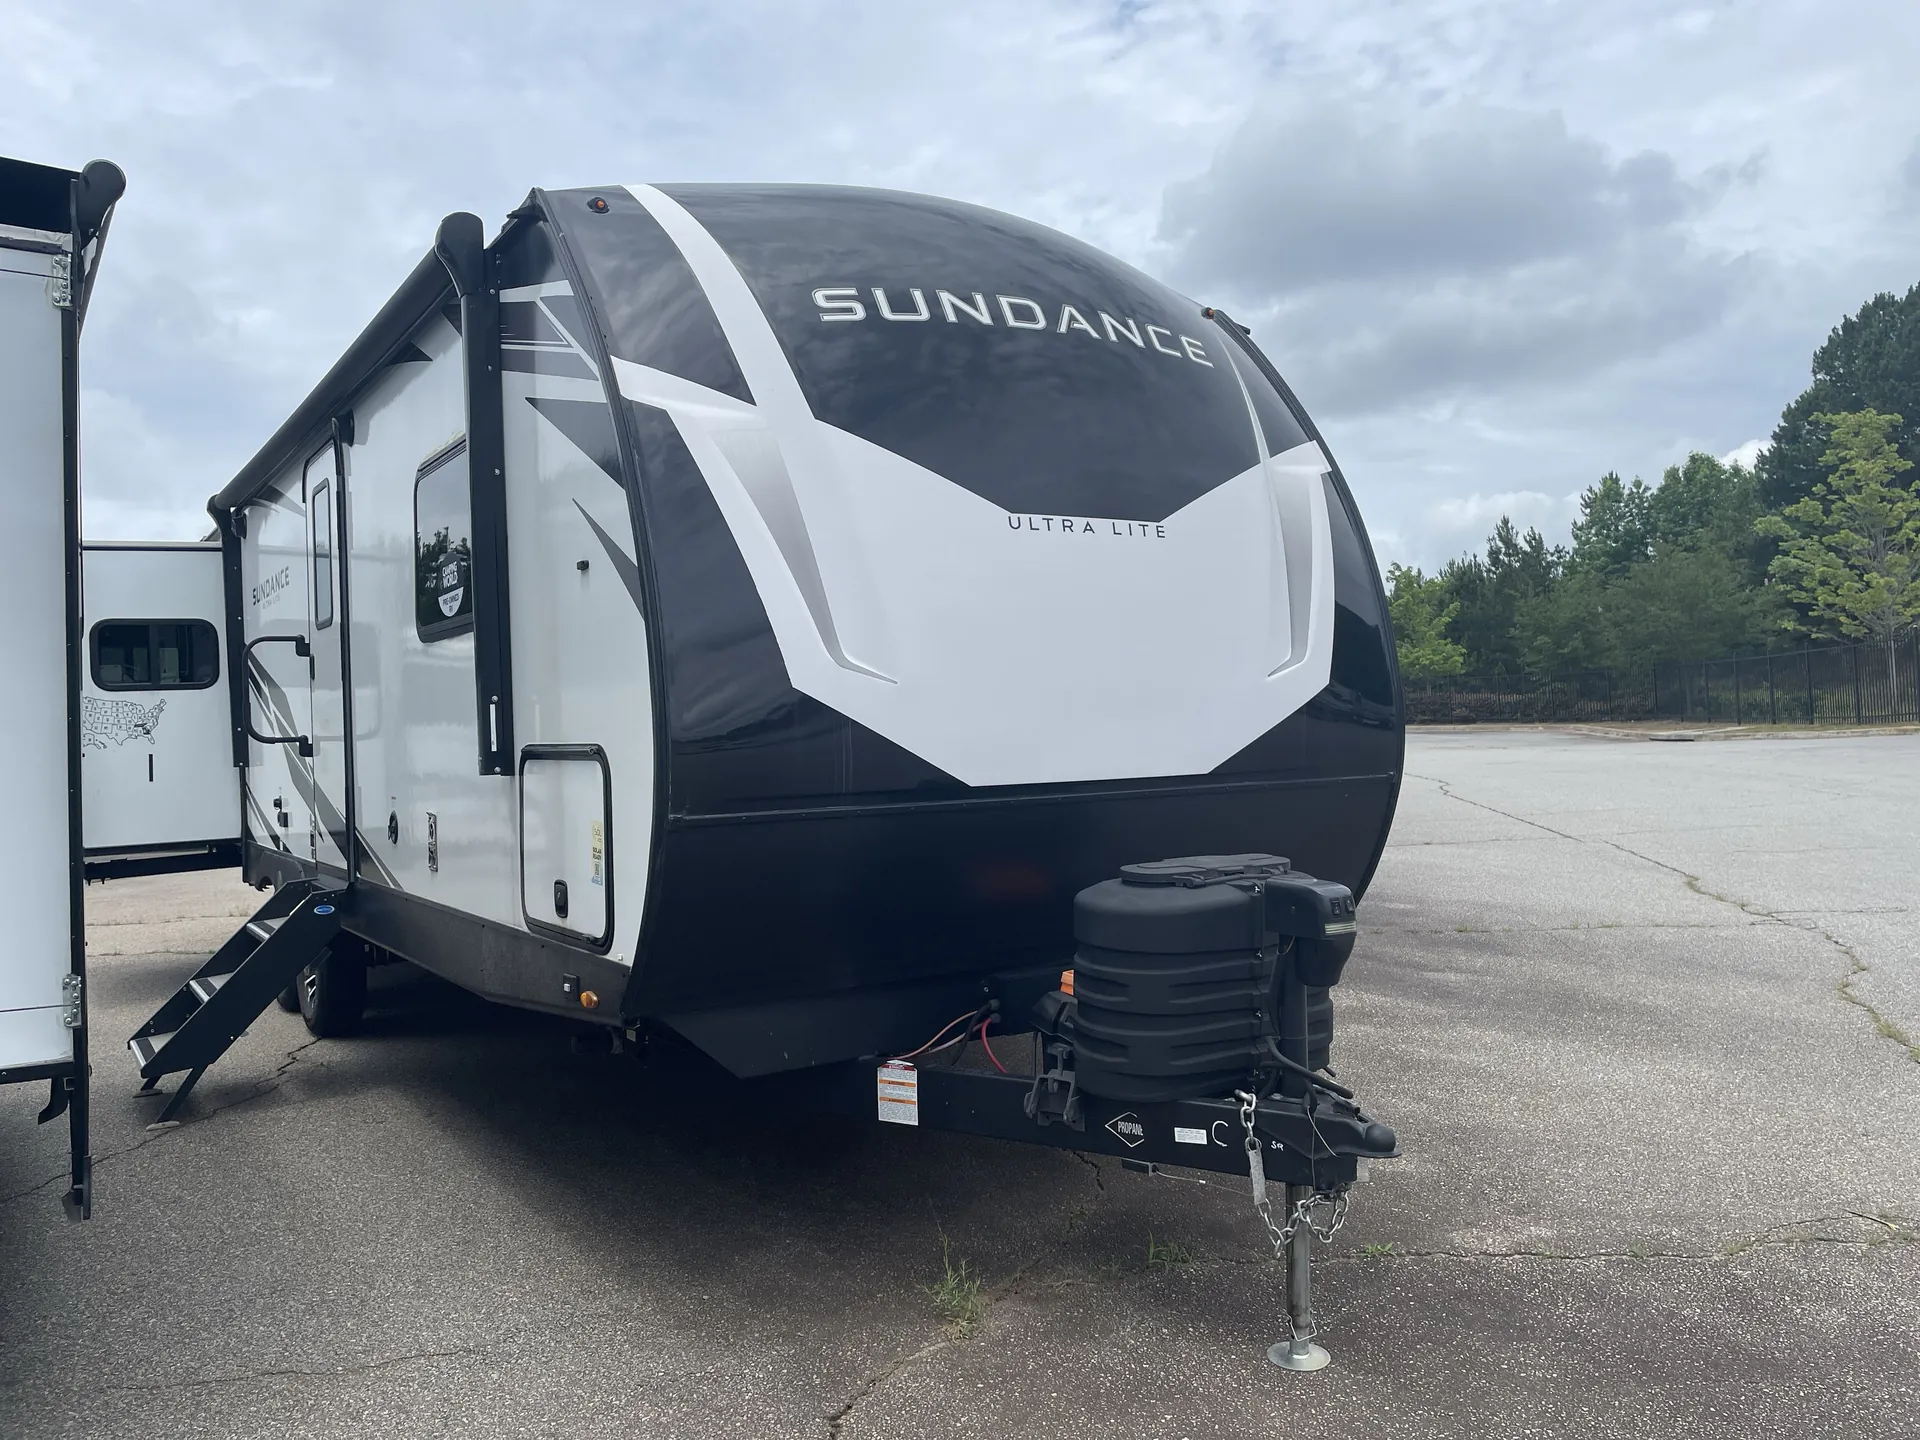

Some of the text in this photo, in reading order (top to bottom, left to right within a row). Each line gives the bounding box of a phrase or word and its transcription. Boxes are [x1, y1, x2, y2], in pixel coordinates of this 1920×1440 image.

[811, 287, 1215, 368] SUNDANCE
[1008, 516, 1166, 539] ULTRA LITE
[252, 565, 290, 606] SUNDANCE
[1117, 1120, 1144, 1136] PROPANE
